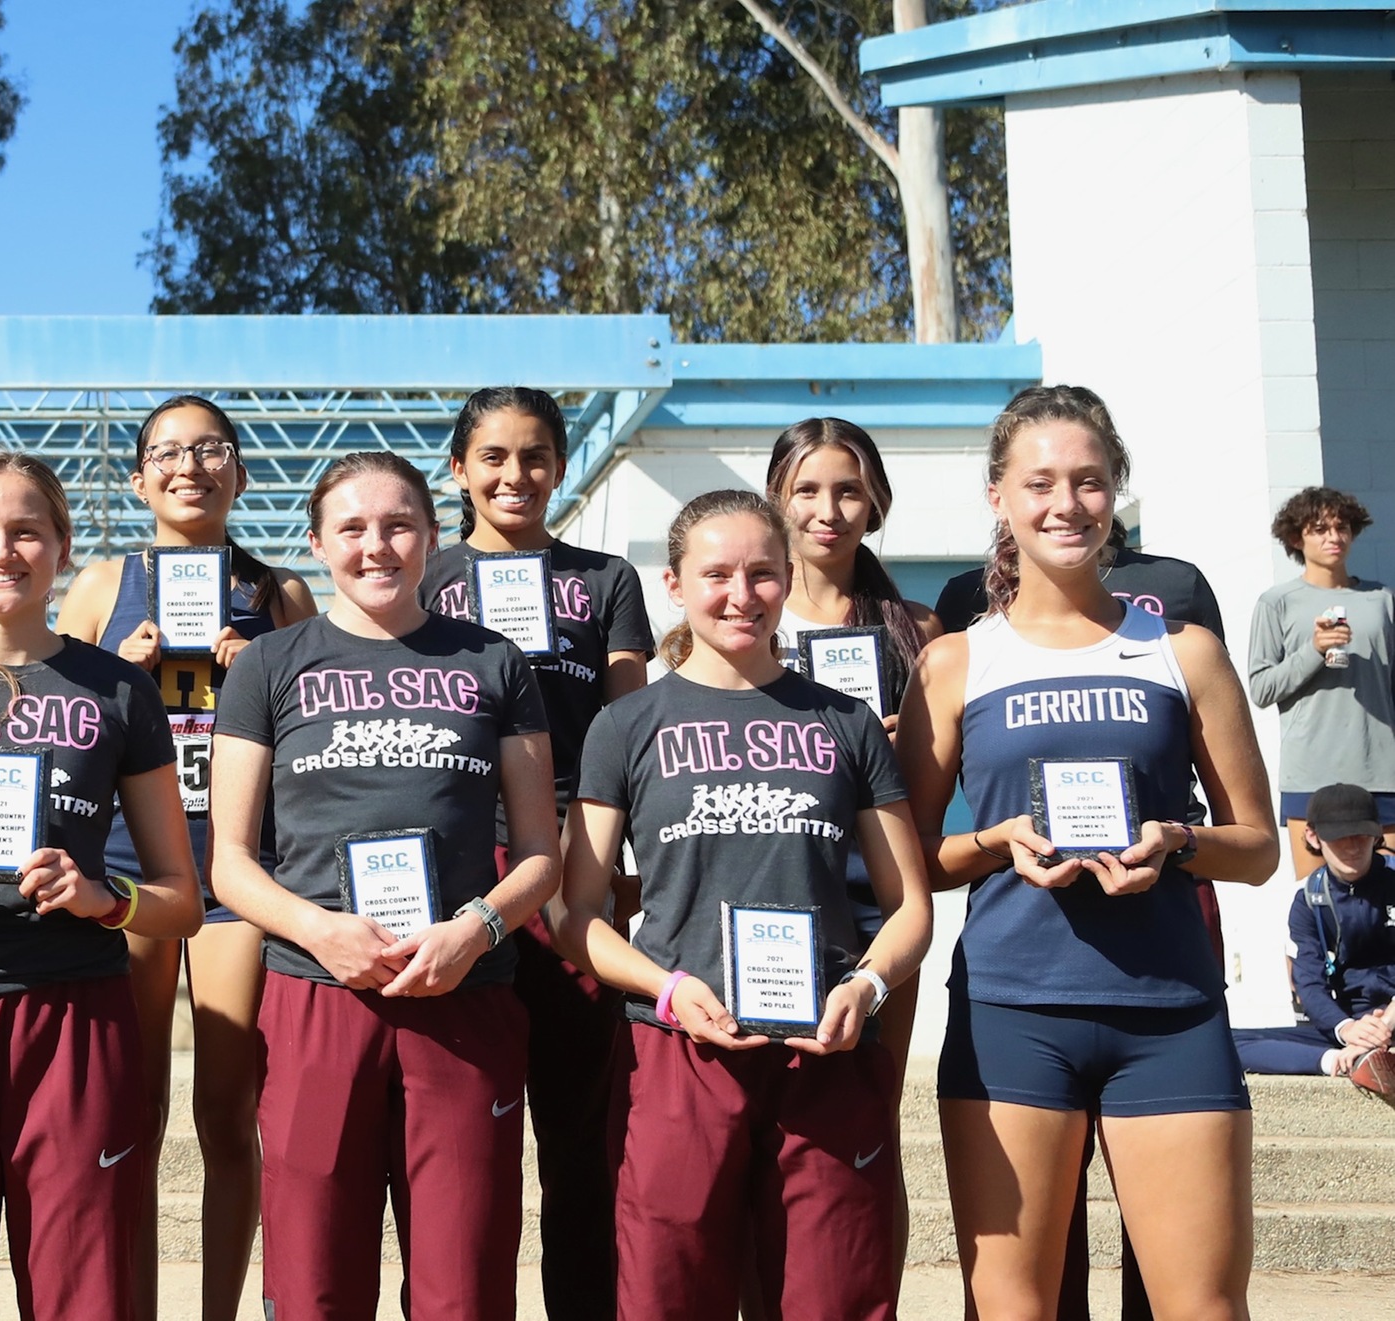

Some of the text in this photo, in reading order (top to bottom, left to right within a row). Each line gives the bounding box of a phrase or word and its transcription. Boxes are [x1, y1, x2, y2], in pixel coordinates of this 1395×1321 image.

[172, 564, 207, 577] SCC
[492, 569, 529, 583] SCC
[825, 647, 863, 662] SCC
[299, 669, 385, 717] MT.
[388, 668, 479, 714] SAC
[1006, 687, 1149, 730] CERRITOS
[7, 695, 100, 750] SAC
[657, 721, 836, 778] MT. SAC
[292, 750, 492, 776] CROSS COUNTRY
[1061, 771, 1104, 784] SCC
[659, 818, 844, 843] CROSS COUNTRY
[367, 852, 408, 870] SCC
[365, 896, 420, 906] CROSS COUNTRY
[752, 924, 794, 939] SCC
[747, 978, 804, 986] CHAMPIONSHIPS
